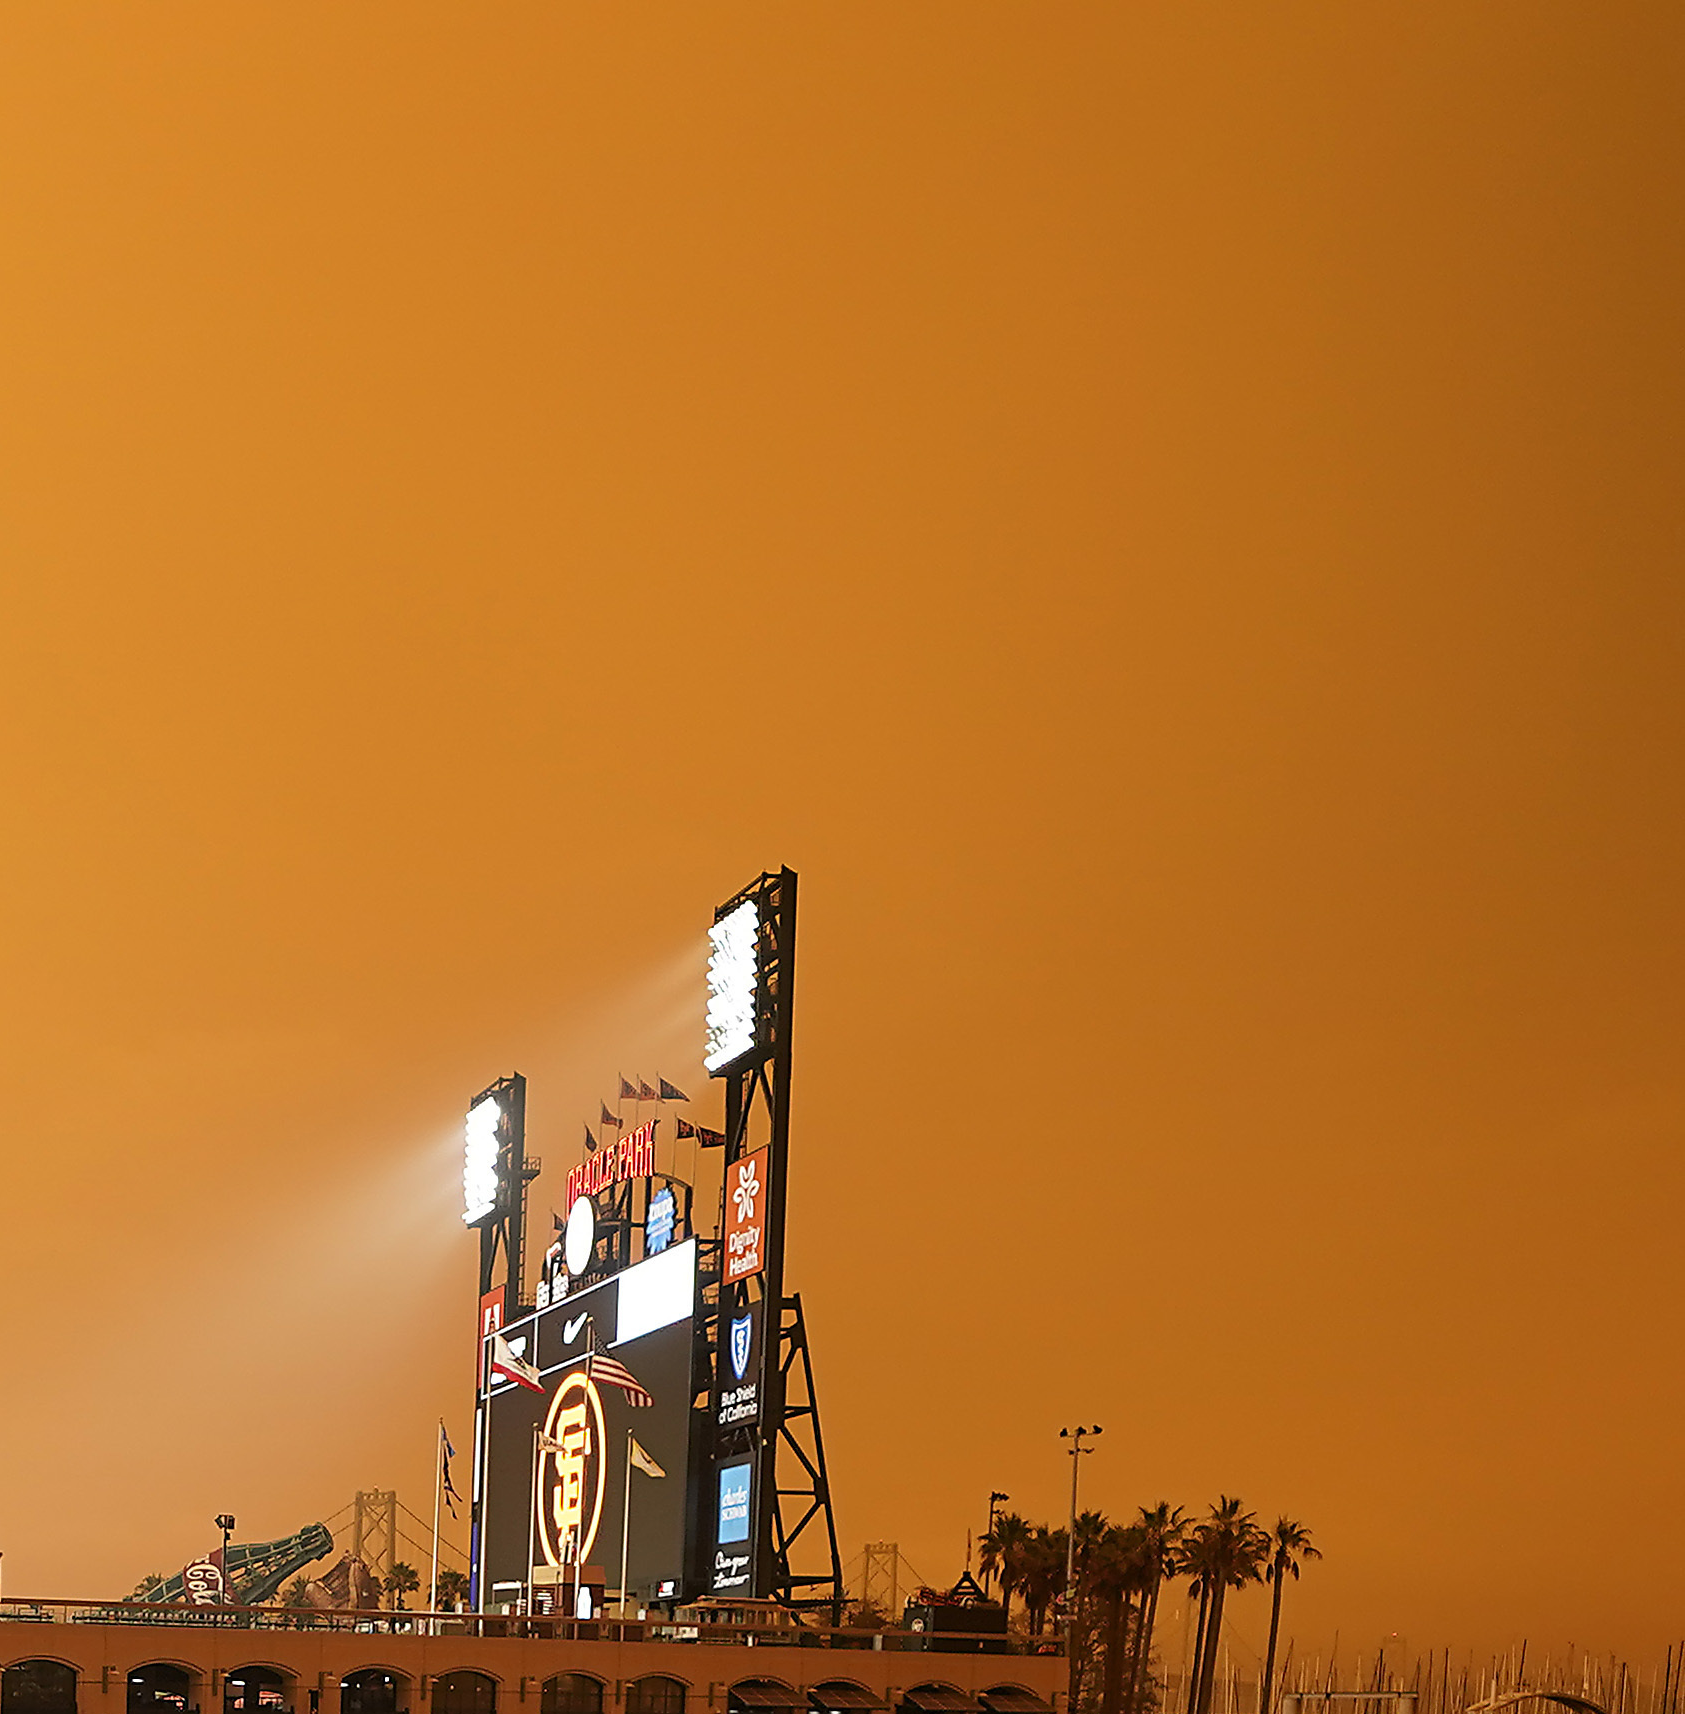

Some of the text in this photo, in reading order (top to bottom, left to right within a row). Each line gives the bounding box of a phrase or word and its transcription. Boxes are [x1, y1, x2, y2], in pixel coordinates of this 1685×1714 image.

[566, 1119, 655, 1222] ORACLE PARK
[729, 1226, 761, 1254] Dignity
[729, 1248, 758, 1277] Health
